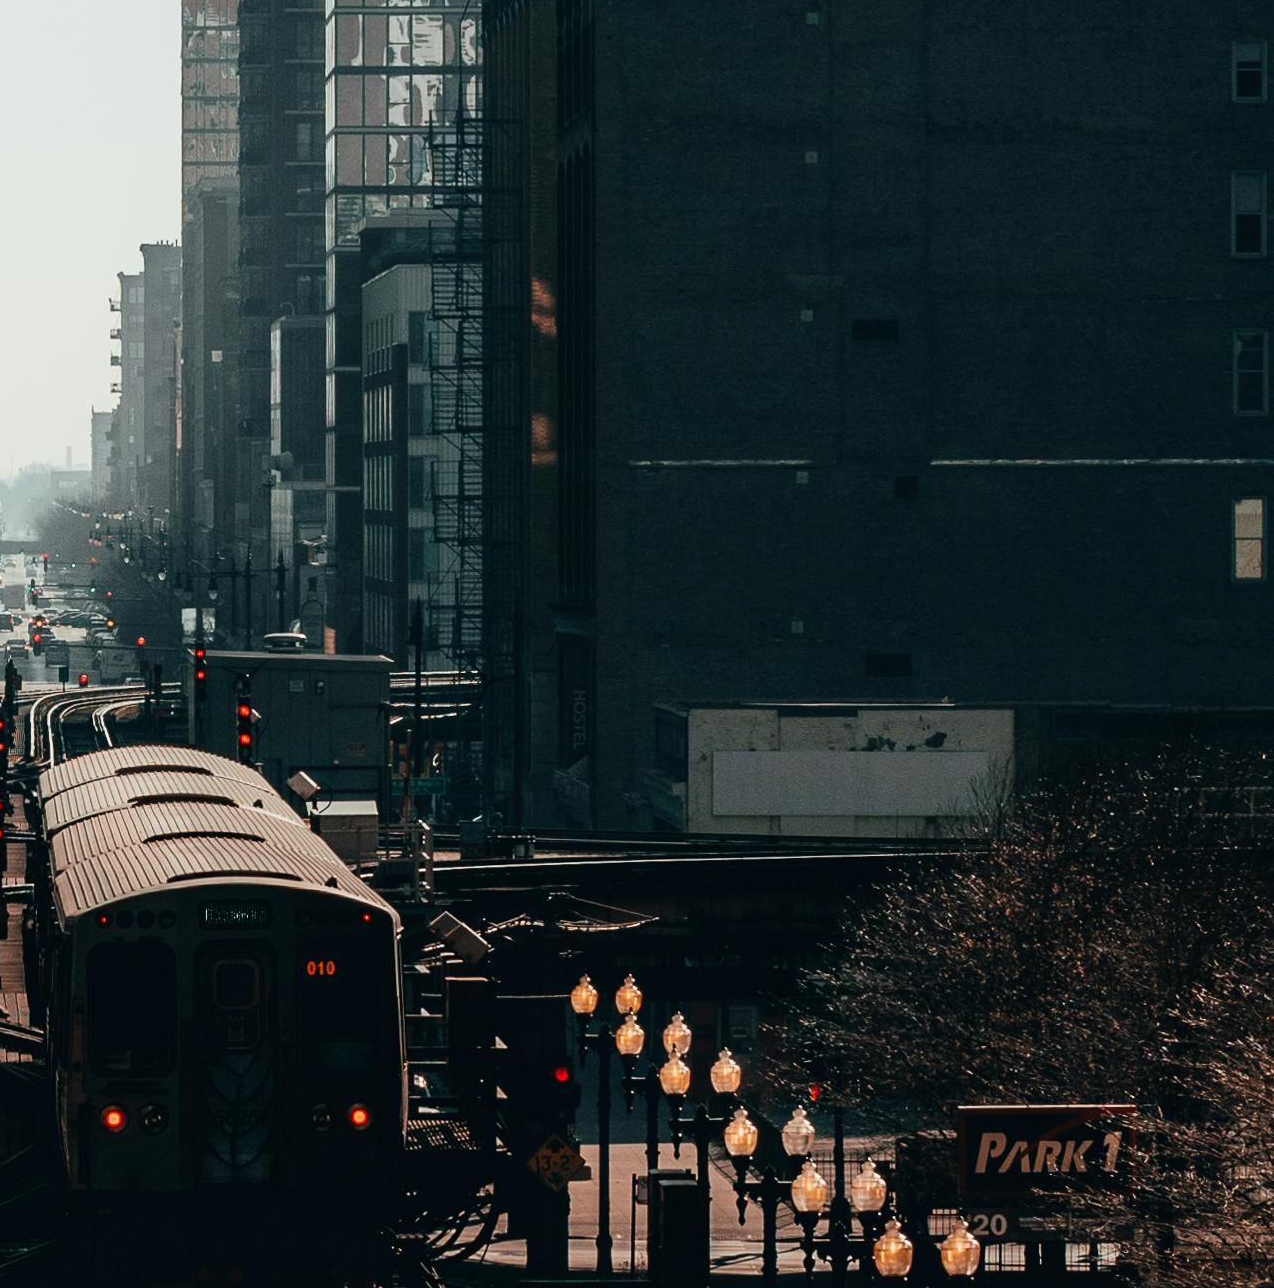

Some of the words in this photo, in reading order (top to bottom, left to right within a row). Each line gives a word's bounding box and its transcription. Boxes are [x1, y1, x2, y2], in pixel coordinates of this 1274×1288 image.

[573, 690, 587, 750] HOSTEL
[306, 959, 336, 977] 010
[974, 1131, 1095, 1174] PARK
[1100, 1130, 1124, 1174] 1
